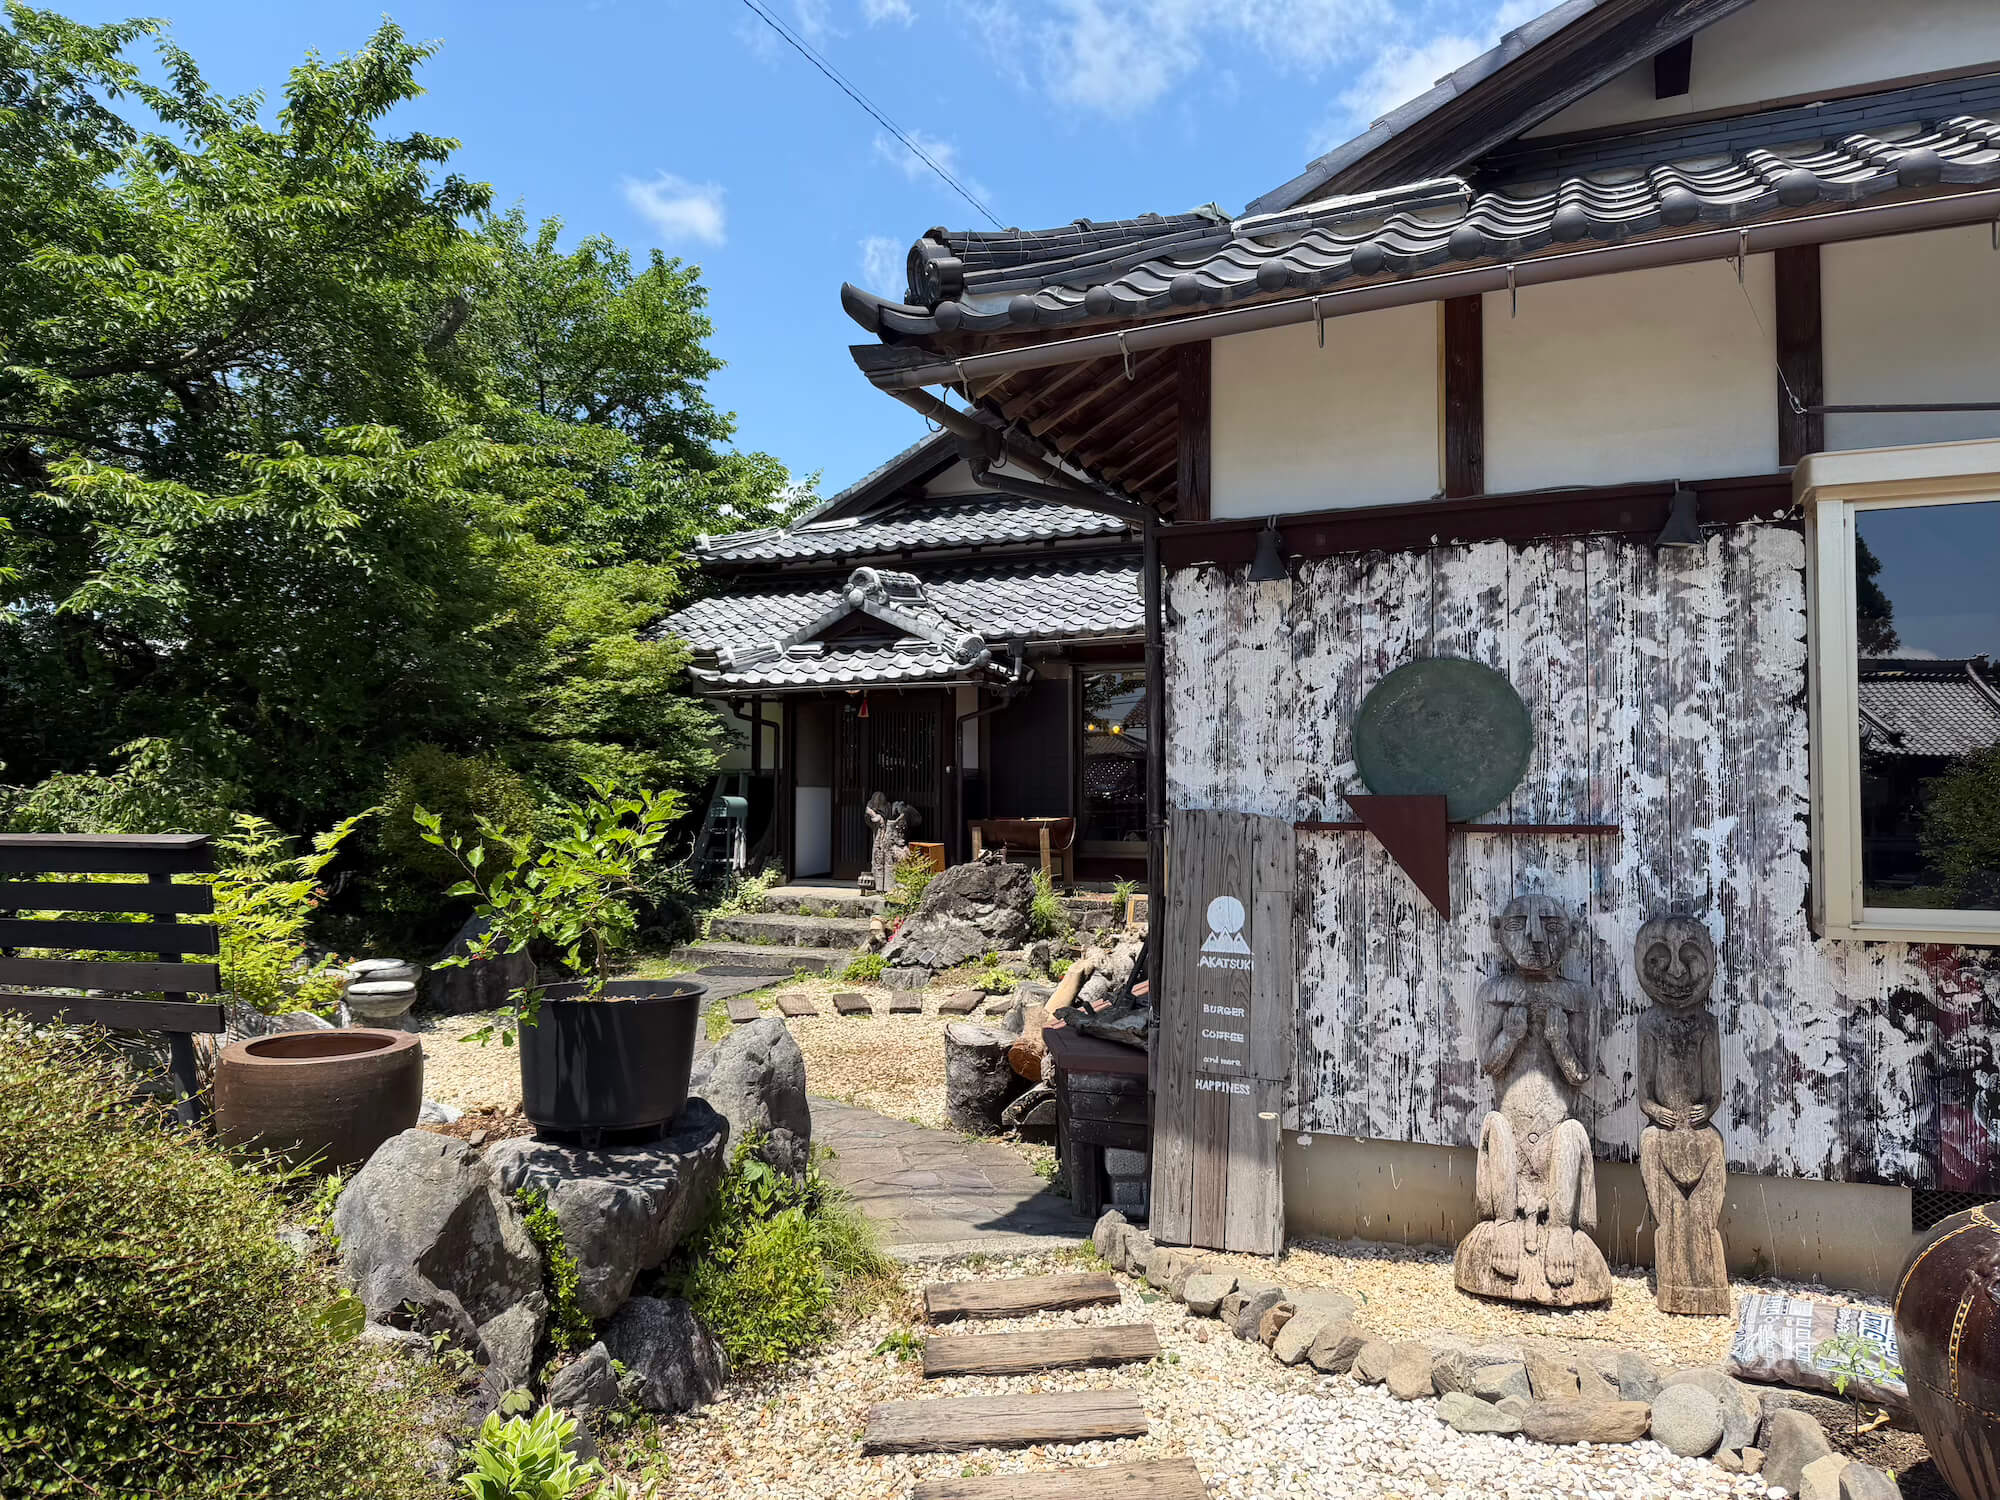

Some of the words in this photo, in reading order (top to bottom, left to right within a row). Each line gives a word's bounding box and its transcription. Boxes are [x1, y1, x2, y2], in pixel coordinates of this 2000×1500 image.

[1199, 955, 1255, 971] AKATSUKI
[1203, 1003, 1245, 1018] BURGER
[1201, 1028, 1245, 1043] COFFEE
[1203, 1055, 1219, 1064] and
[1195, 1079, 1250, 1096] HAPPINESS
